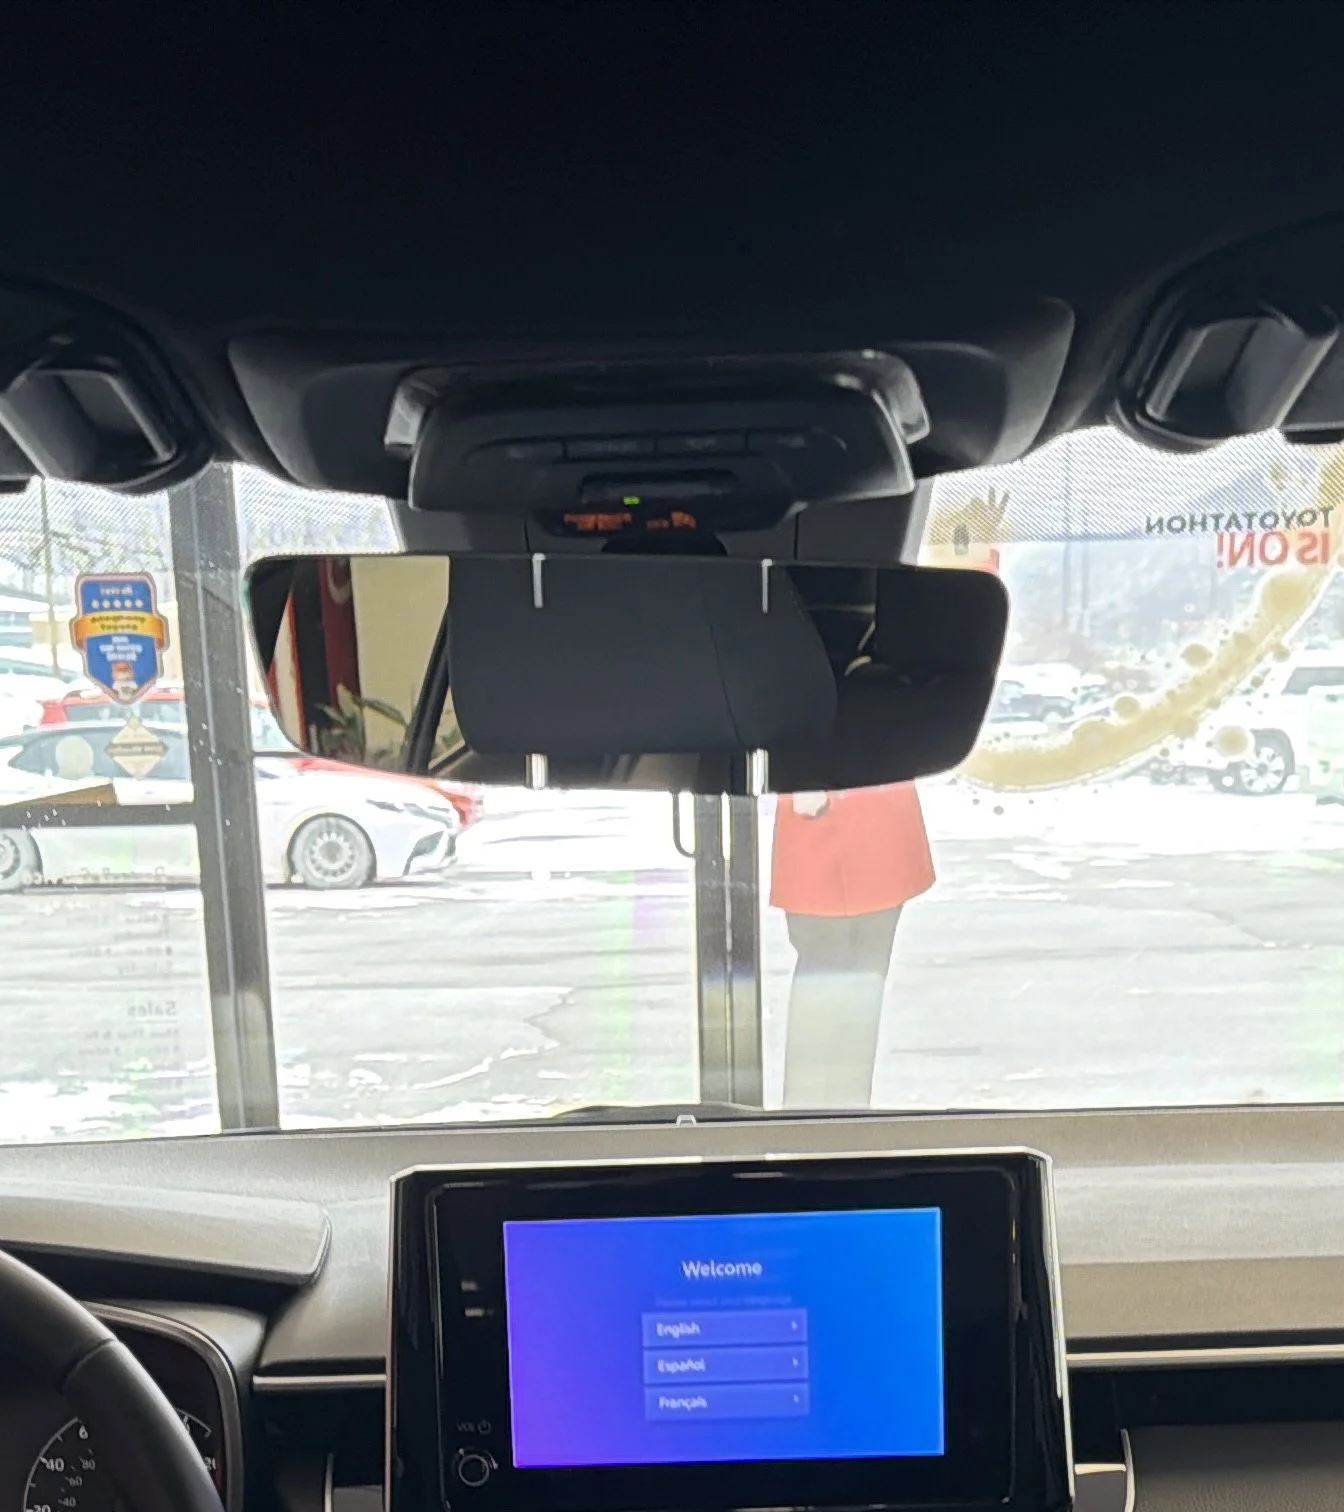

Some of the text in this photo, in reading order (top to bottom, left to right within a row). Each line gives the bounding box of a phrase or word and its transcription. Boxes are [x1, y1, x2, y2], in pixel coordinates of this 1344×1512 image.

[681, 1260, 763, 1278] Welcome
[656, 1321, 701, 1338] English
[45, 1457, 65, 1472] 40
